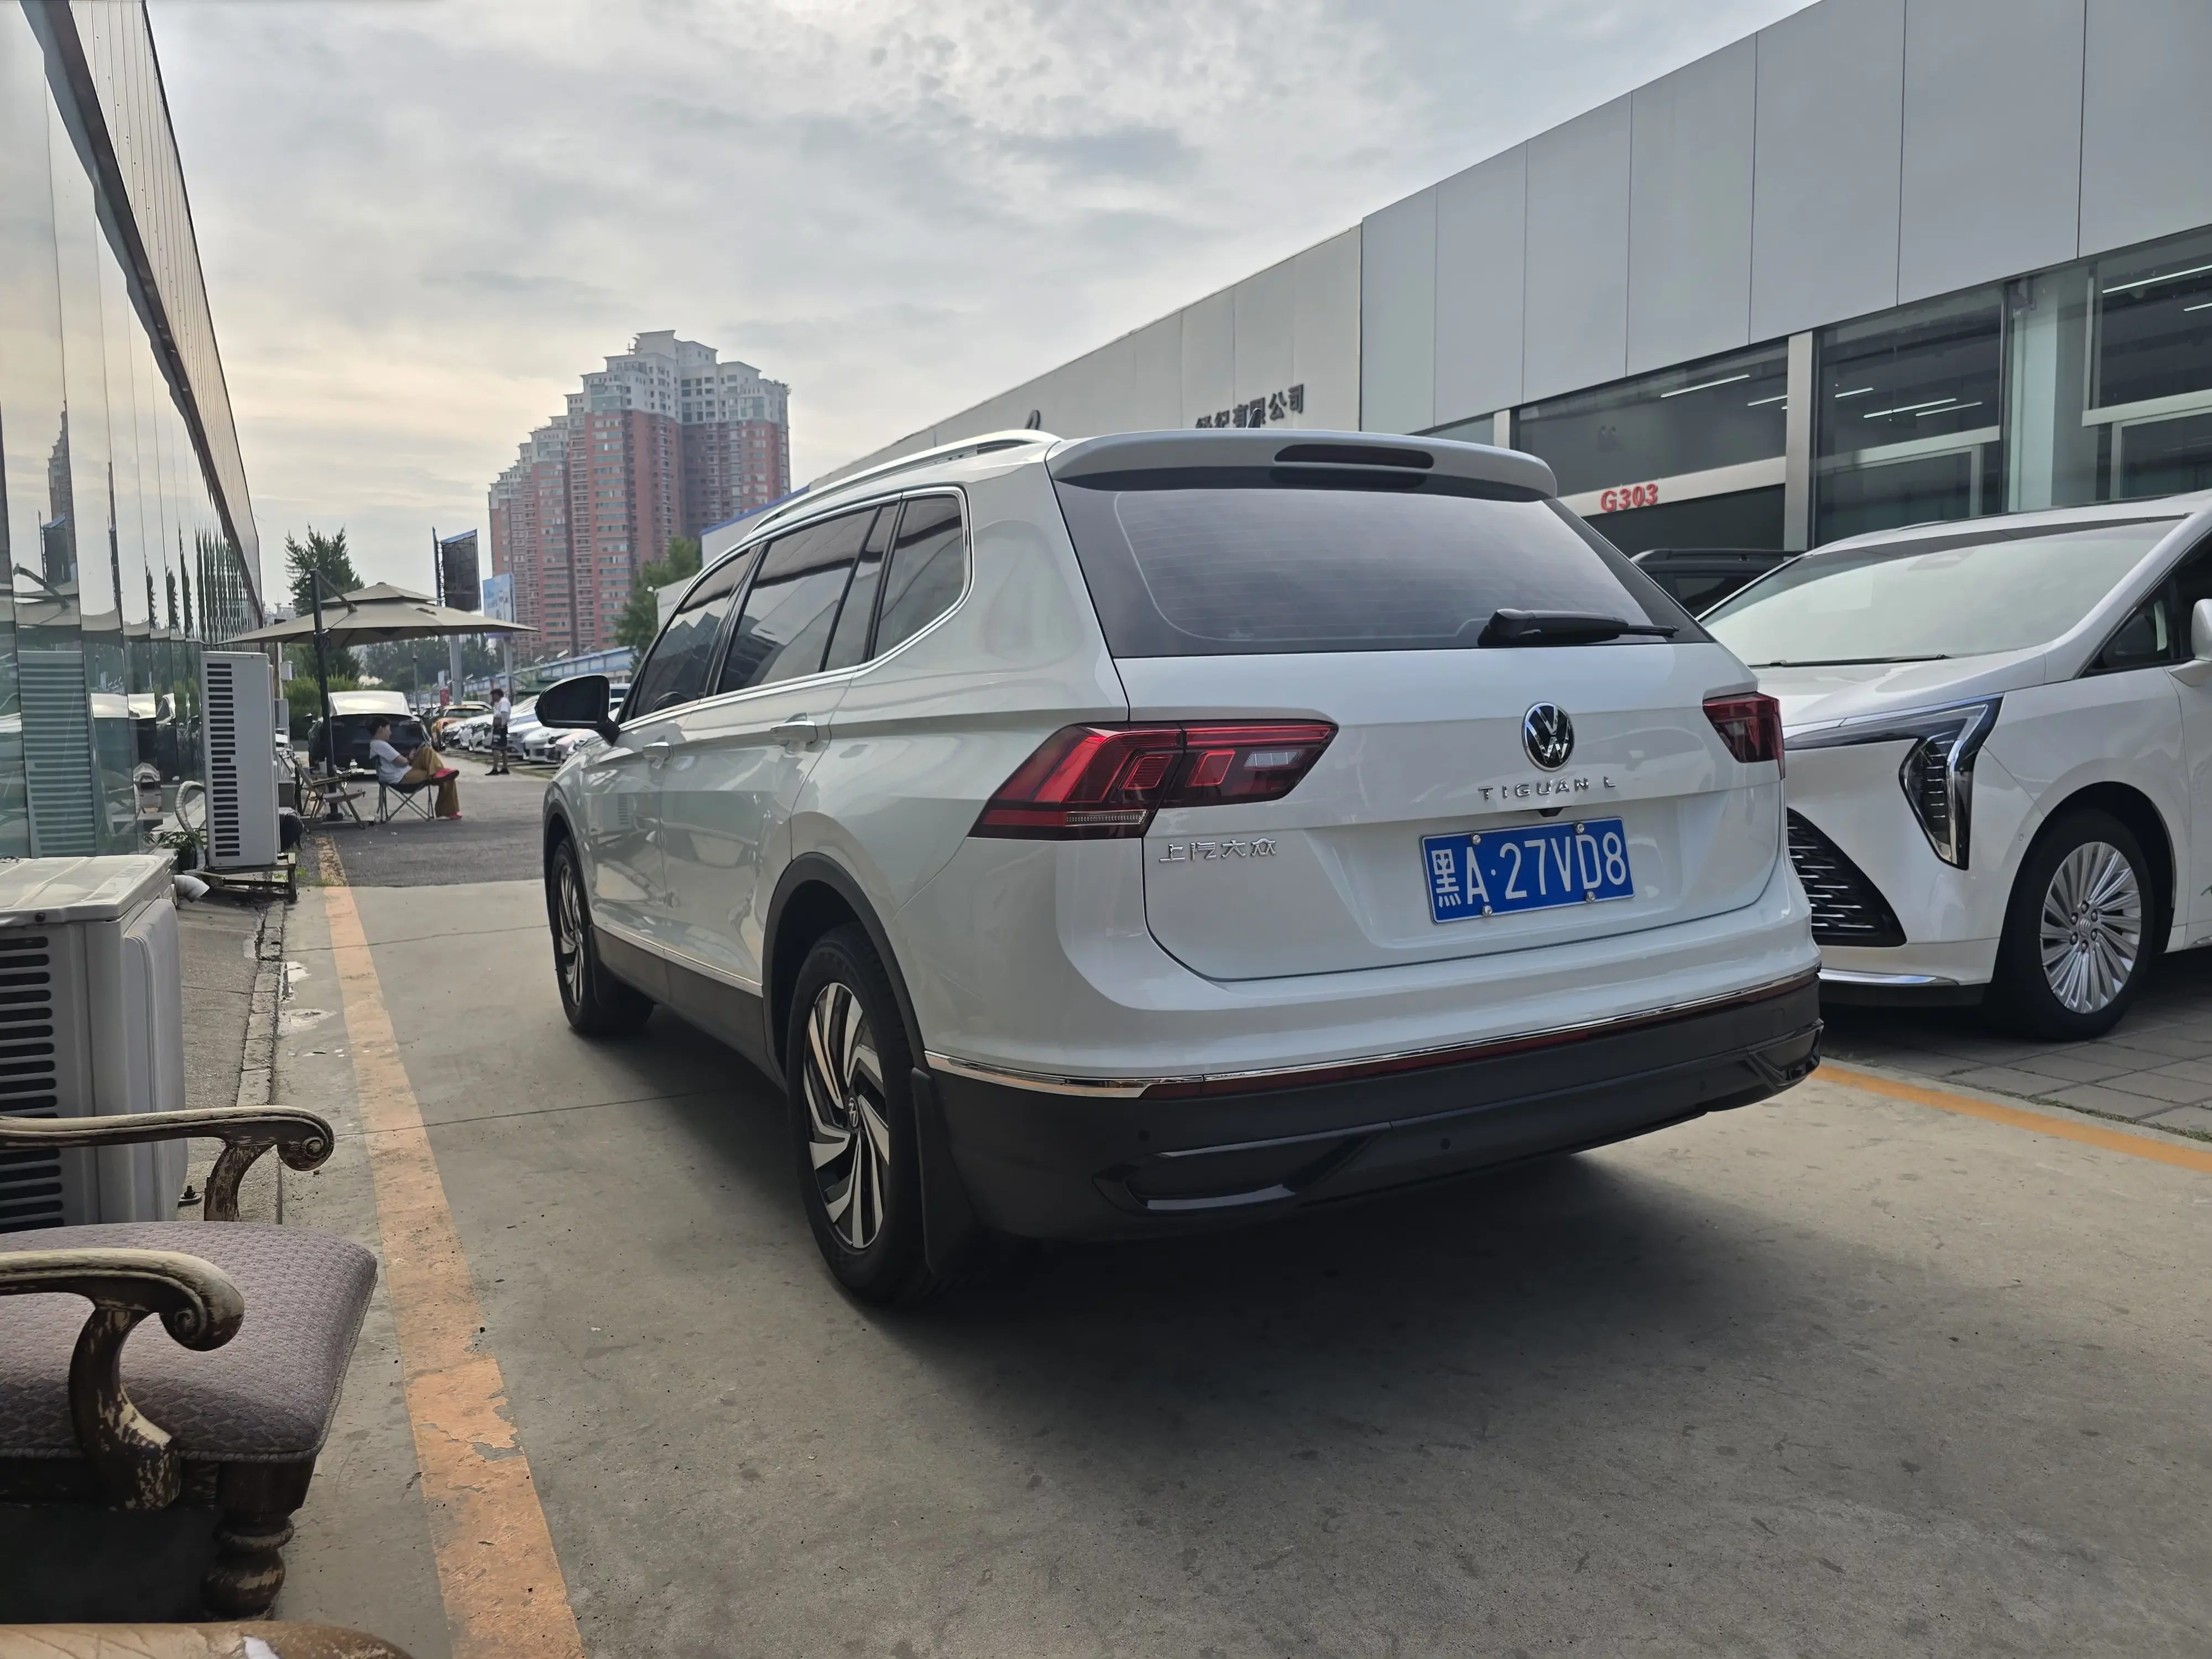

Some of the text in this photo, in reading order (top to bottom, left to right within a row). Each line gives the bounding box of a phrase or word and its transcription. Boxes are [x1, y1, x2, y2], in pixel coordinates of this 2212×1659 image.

[1601, 483, 1658, 512] G303
[1478, 776, 1616, 801] TIGUAN L
[1159, 838, 1276, 863] 上汽大众
